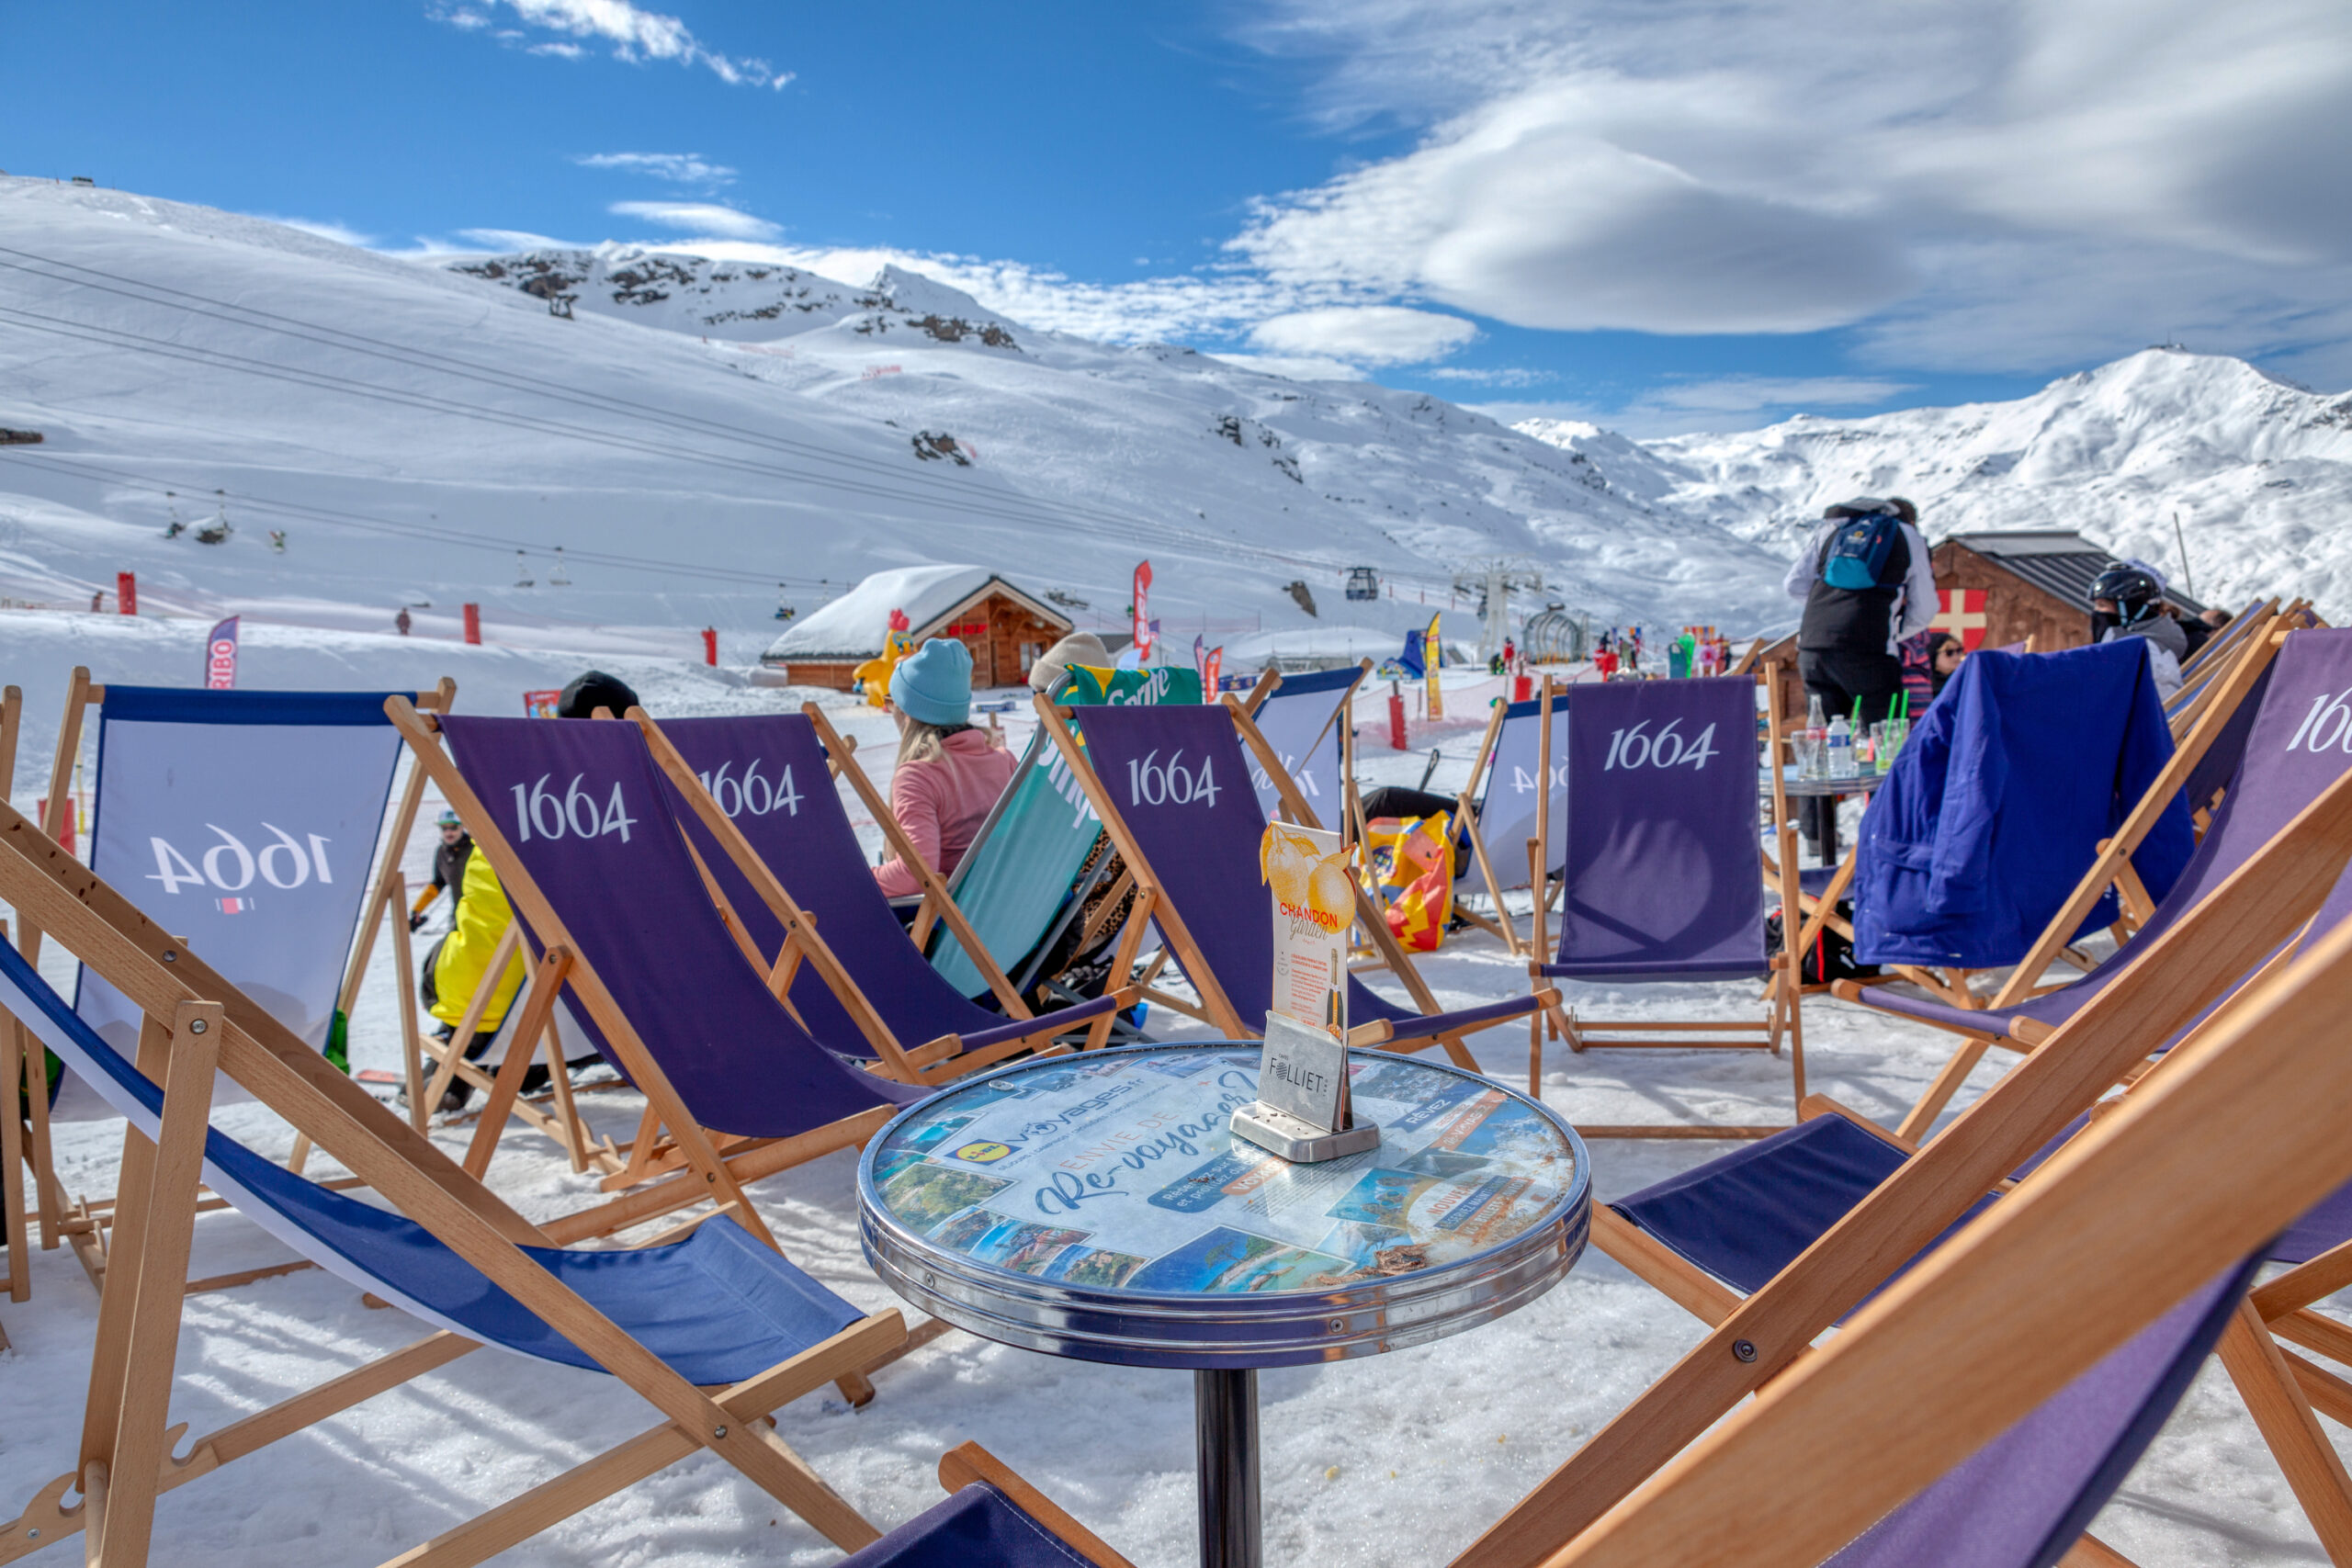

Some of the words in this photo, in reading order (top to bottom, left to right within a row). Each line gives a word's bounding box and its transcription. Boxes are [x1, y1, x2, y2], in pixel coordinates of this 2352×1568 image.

[1107, 668, 1170, 705] rite
[1604, 717, 1720, 772] 1664
[2285, 686, 2352, 753] 16
[698, 758, 805, 818] 1664
[1126, 749, 1223, 808] 1664
[510, 773, 638, 843] 1664
[1279, 902, 1338, 928] CHANDON
[1269, 1057, 1324, 1093] FOLLIET
[1405, 1099, 1453, 1124] RÊVEZ
[1058, 1131, 1143, 1170] ENVIE
[1136, 1111, 1181, 1130] DE
